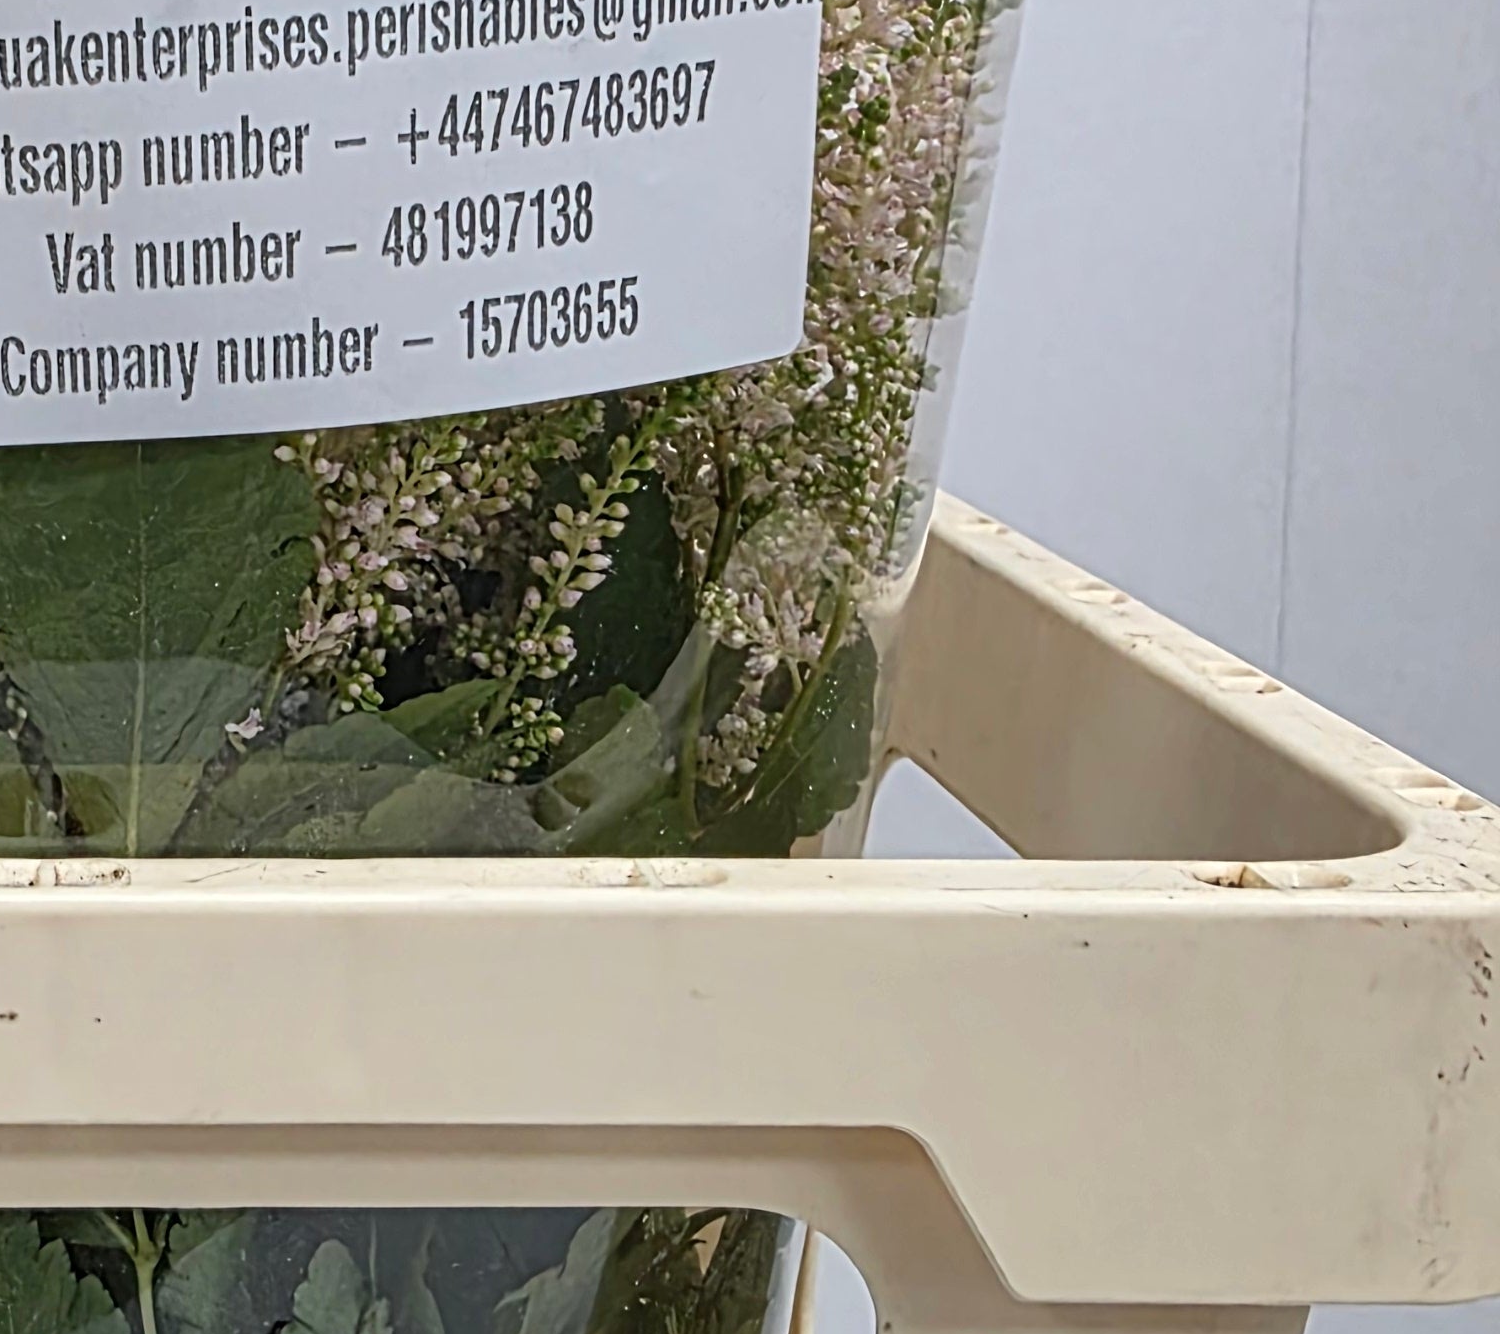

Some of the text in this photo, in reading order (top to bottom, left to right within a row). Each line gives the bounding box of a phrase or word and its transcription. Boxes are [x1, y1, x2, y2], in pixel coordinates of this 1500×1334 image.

[143, 115, 309, 186] number
[398, 60, 715, 164] +447467483697
[46, 233, 115, 293] Vat
[136, 222, 301, 289] number
[382, 182, 592, 266] 481997138
[1, 336, 198, 404] Company
[217, 317, 378, 384] number
[460, 276, 638, 359] 15703655
